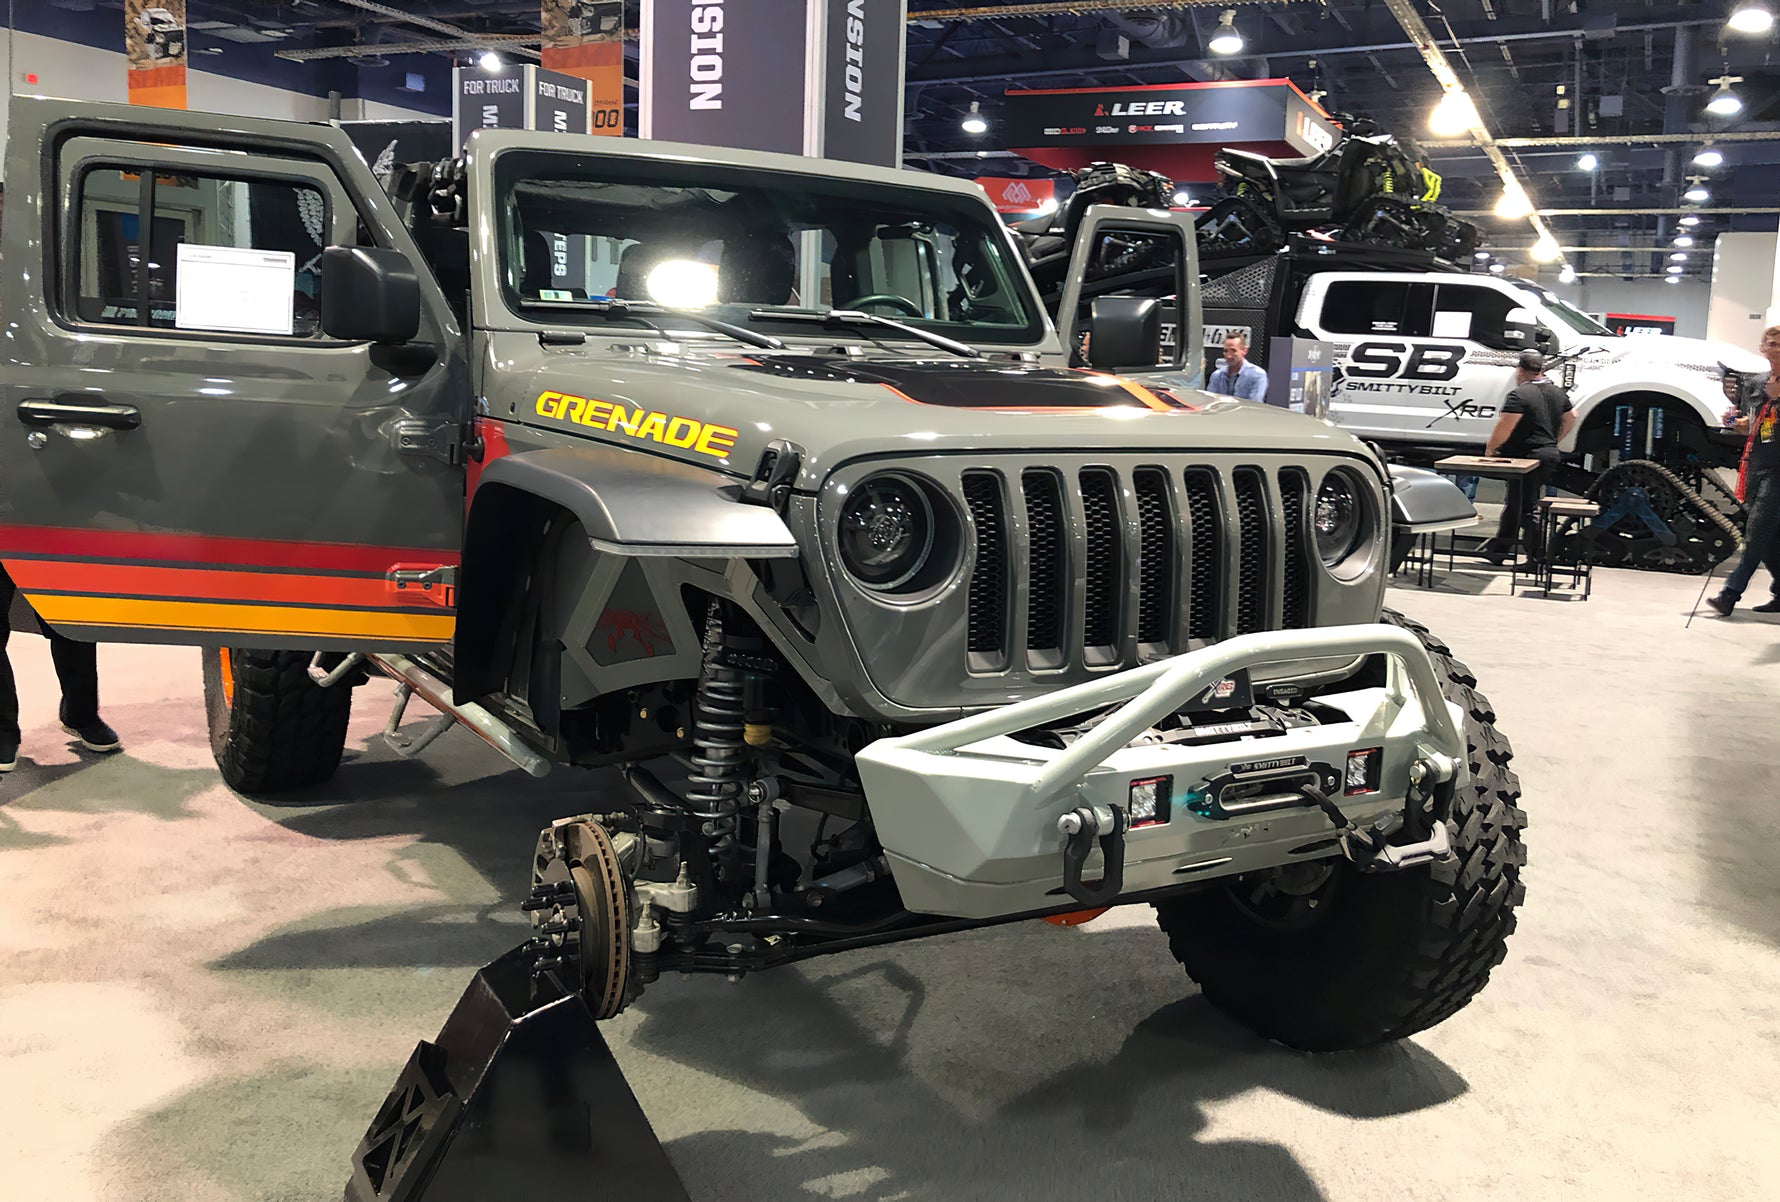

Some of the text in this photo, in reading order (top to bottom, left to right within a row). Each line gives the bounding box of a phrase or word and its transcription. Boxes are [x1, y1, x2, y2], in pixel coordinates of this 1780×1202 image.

[689, 0, 724, 110] SION
[463, 79, 520, 95] FOR TRUCK
[538, 81, 584, 104] FOR TRUCK
[1110, 102, 1187, 117] LEER
[1345, 341, 1467, 381] SB
[1345, 381, 1463, 396] SMITTYBILT
[535, 389, 739, 458] GRENADE
[1425, 399, 1497, 429] XRC
